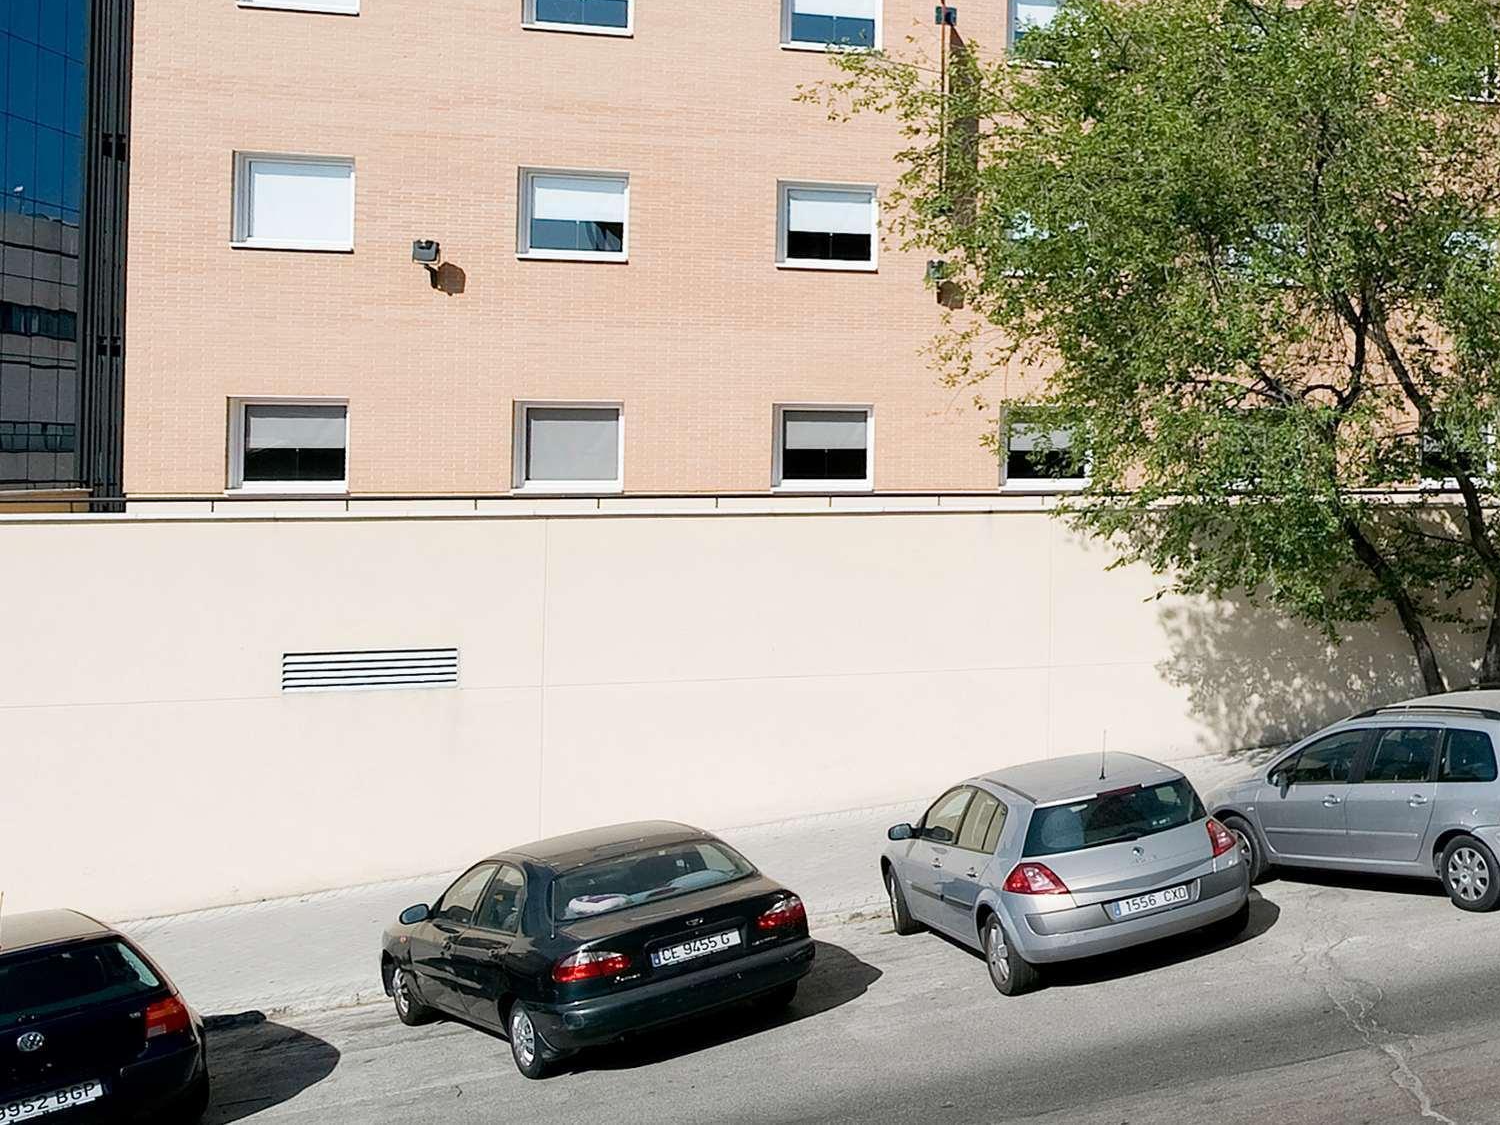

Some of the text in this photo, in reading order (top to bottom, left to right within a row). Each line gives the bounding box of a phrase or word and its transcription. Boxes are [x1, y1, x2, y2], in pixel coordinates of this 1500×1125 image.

[1125, 887, 1187, 912] 1556 CXD
[662, 932, 730, 962] CE 9455 G
[56, 1081, 96, 1105] BGP
